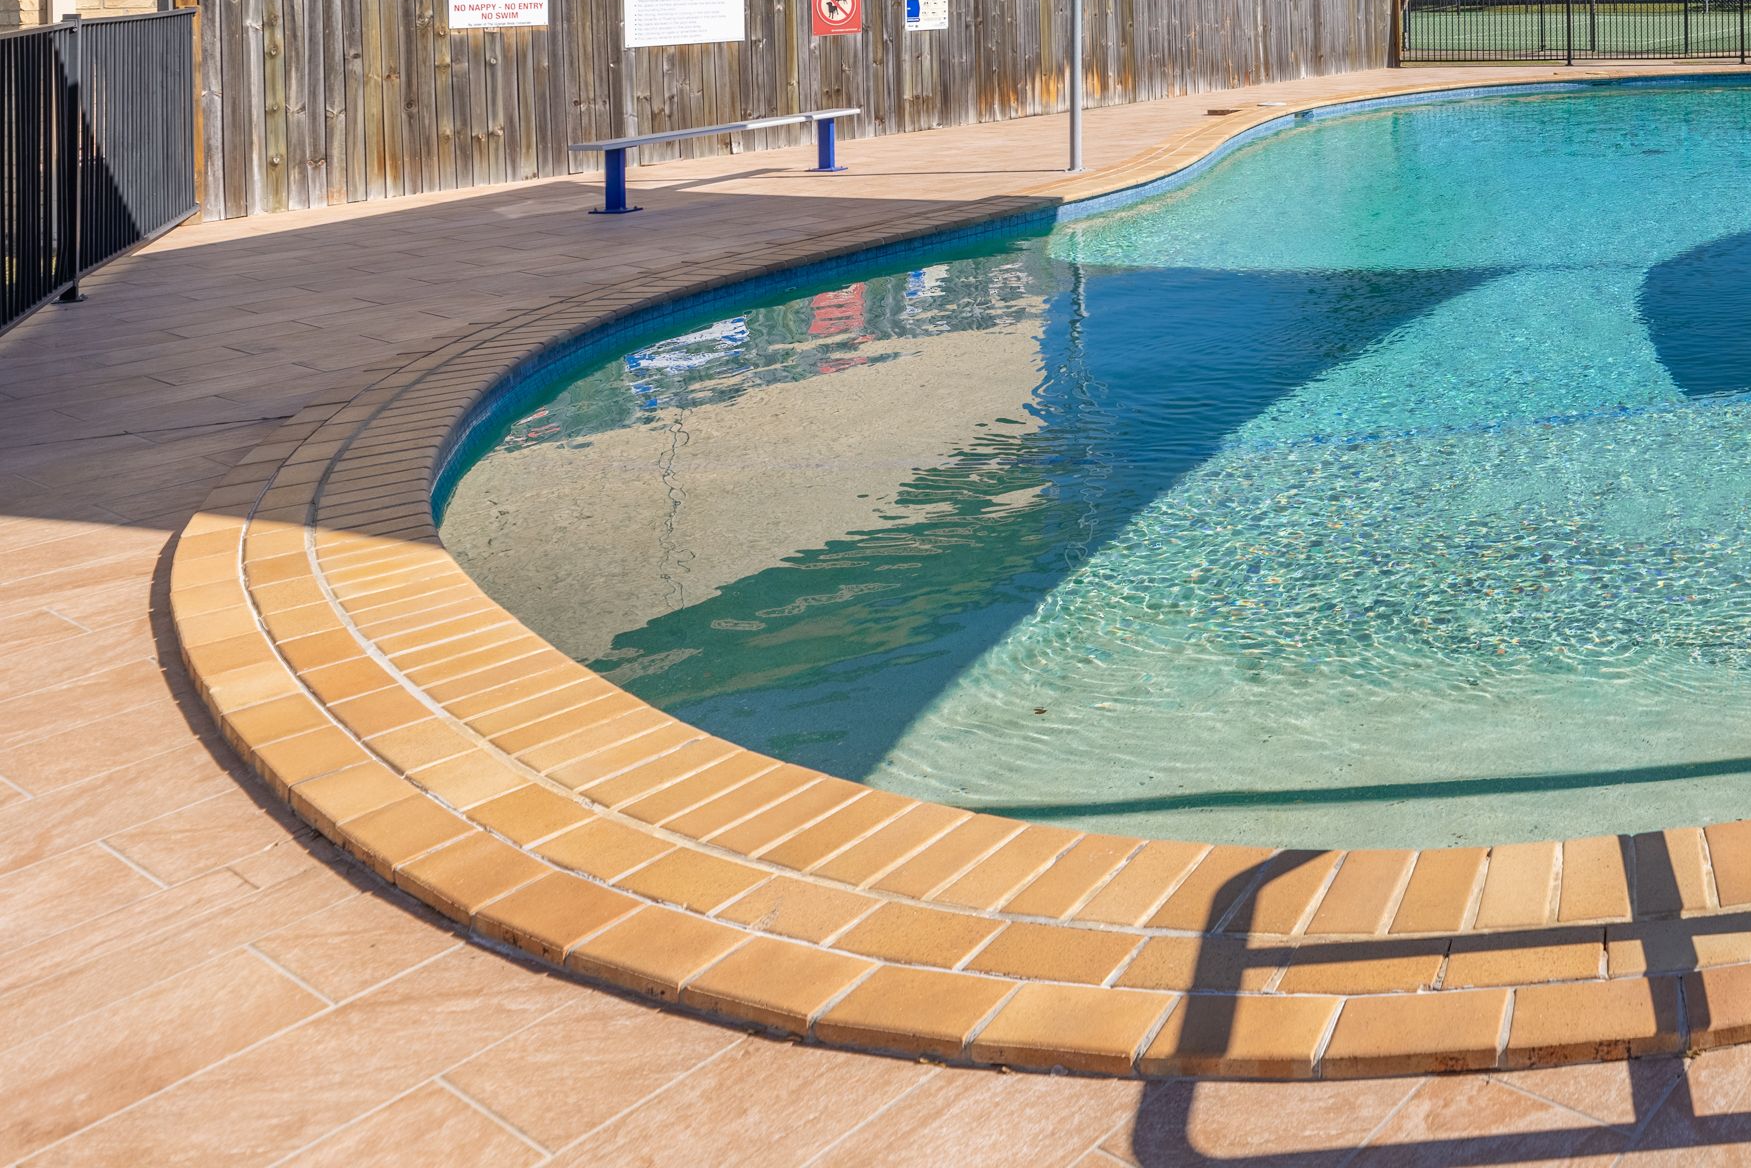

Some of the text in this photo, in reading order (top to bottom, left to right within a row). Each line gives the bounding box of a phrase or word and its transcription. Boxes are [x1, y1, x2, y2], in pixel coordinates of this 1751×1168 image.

[454, 4, 467, 12] NO
[468, 3, 497, 11] NAPPY
[518, 2, 544, 10] ENTRY
[481, 11, 519, 20] NO SWIM
